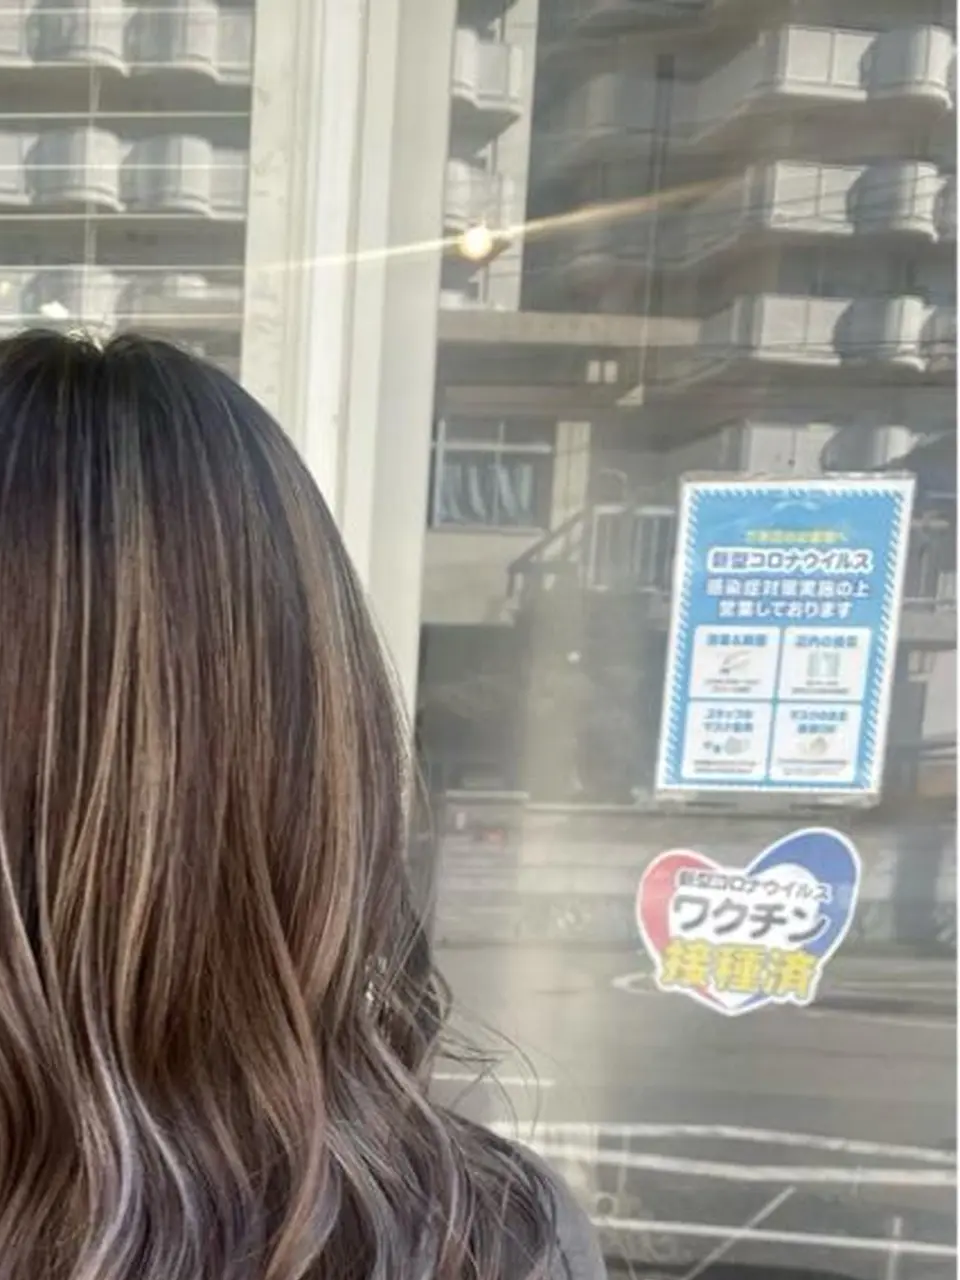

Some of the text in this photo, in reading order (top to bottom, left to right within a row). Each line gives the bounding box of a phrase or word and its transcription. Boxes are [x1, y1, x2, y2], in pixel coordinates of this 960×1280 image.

[674, 894, 826, 942] ワクチン
[662, 939, 816, 999] 接種済
